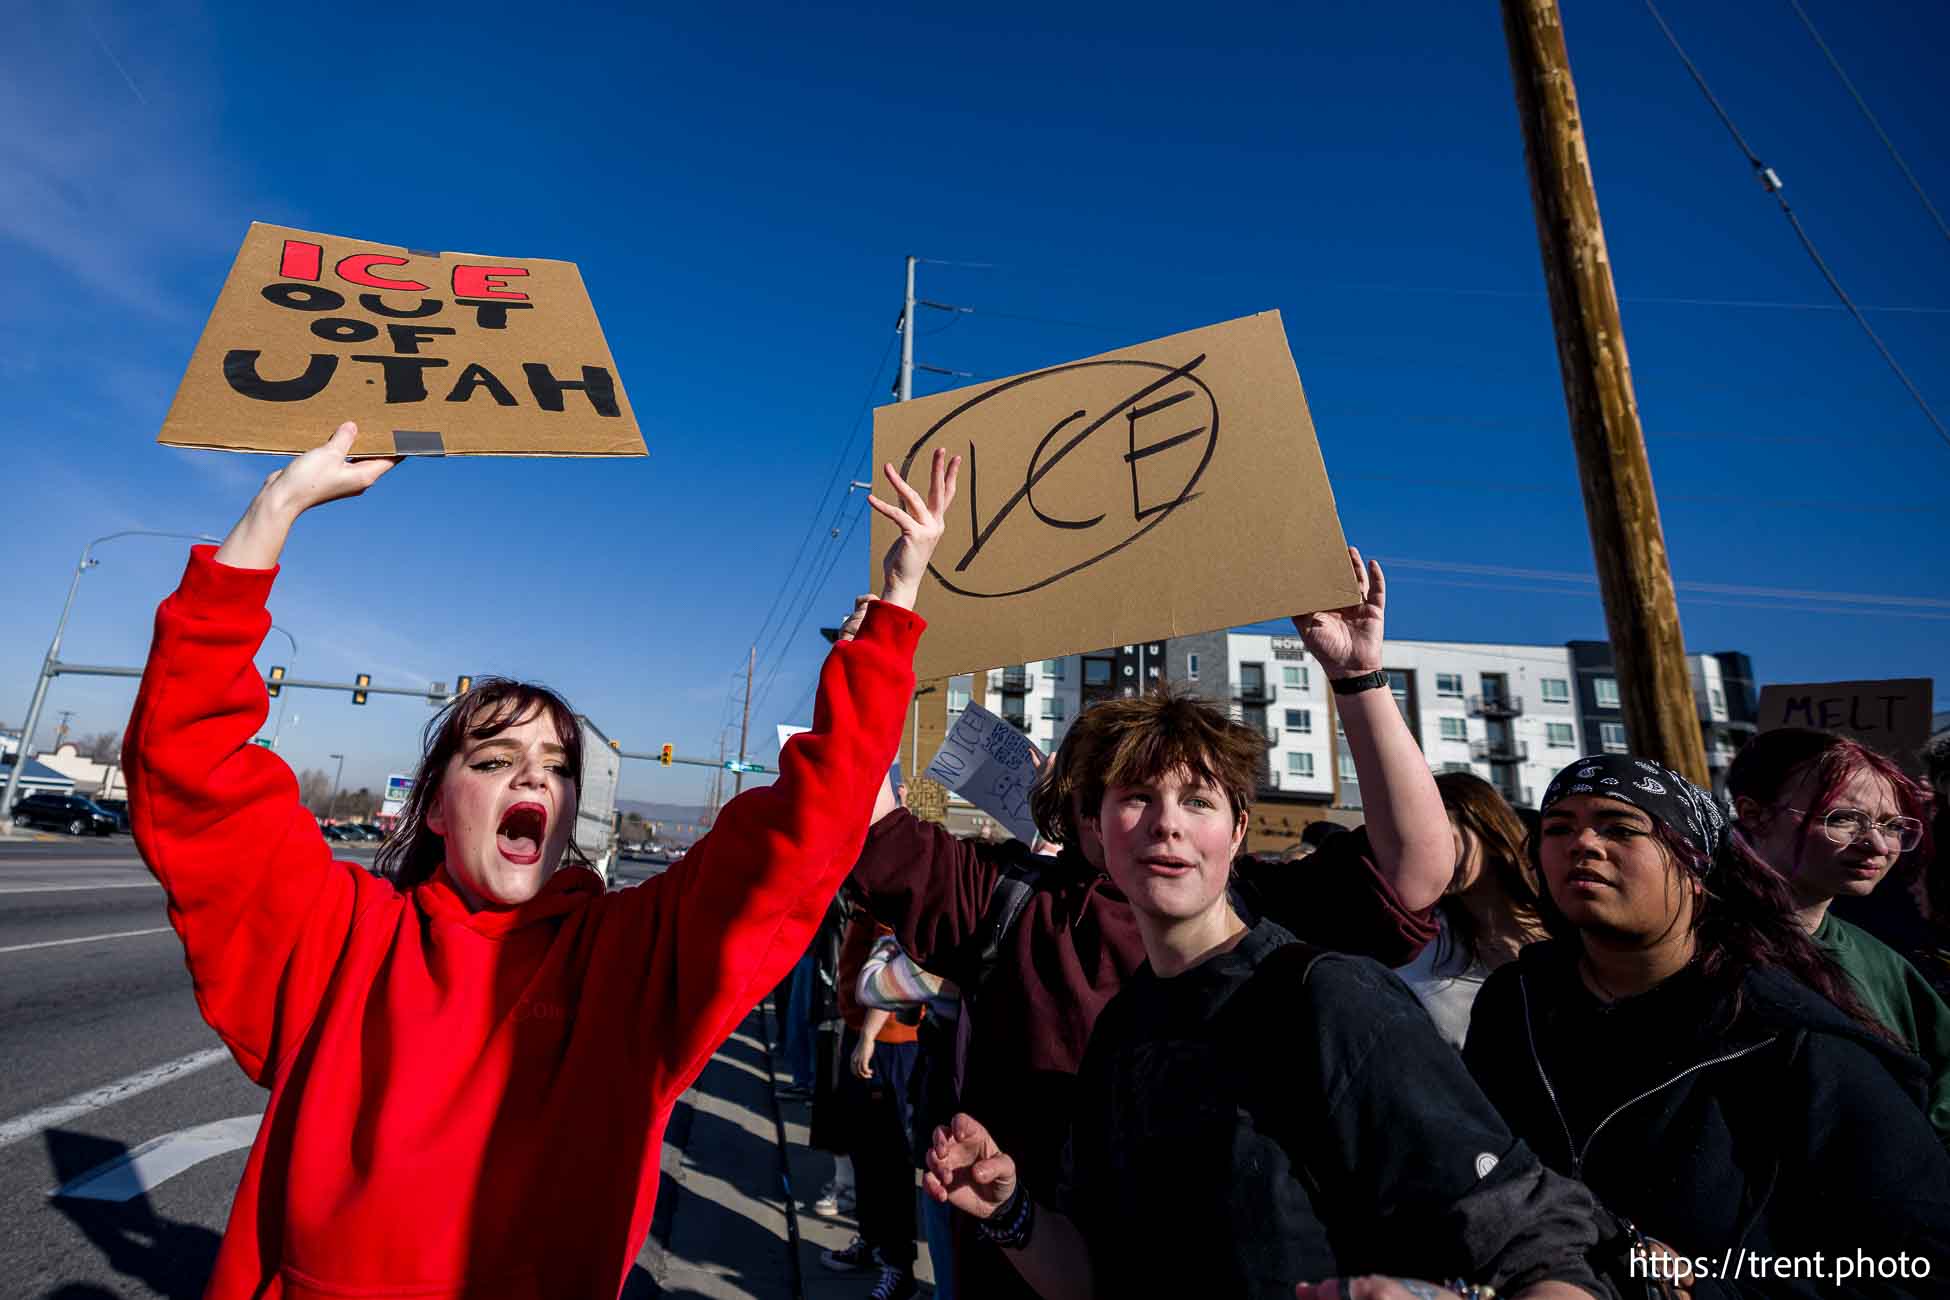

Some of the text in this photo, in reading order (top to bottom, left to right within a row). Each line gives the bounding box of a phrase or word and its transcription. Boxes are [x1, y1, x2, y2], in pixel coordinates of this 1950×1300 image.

[279, 239, 530, 300] ICE
[261, 282, 534, 330] OUT
[310, 317, 456, 354] OF
[222, 349, 621, 418] UTAH
[969, 390, 1207, 552] ICE
[1783, 695, 1909, 732] MELT
[930, 751, 966, 785] NO
